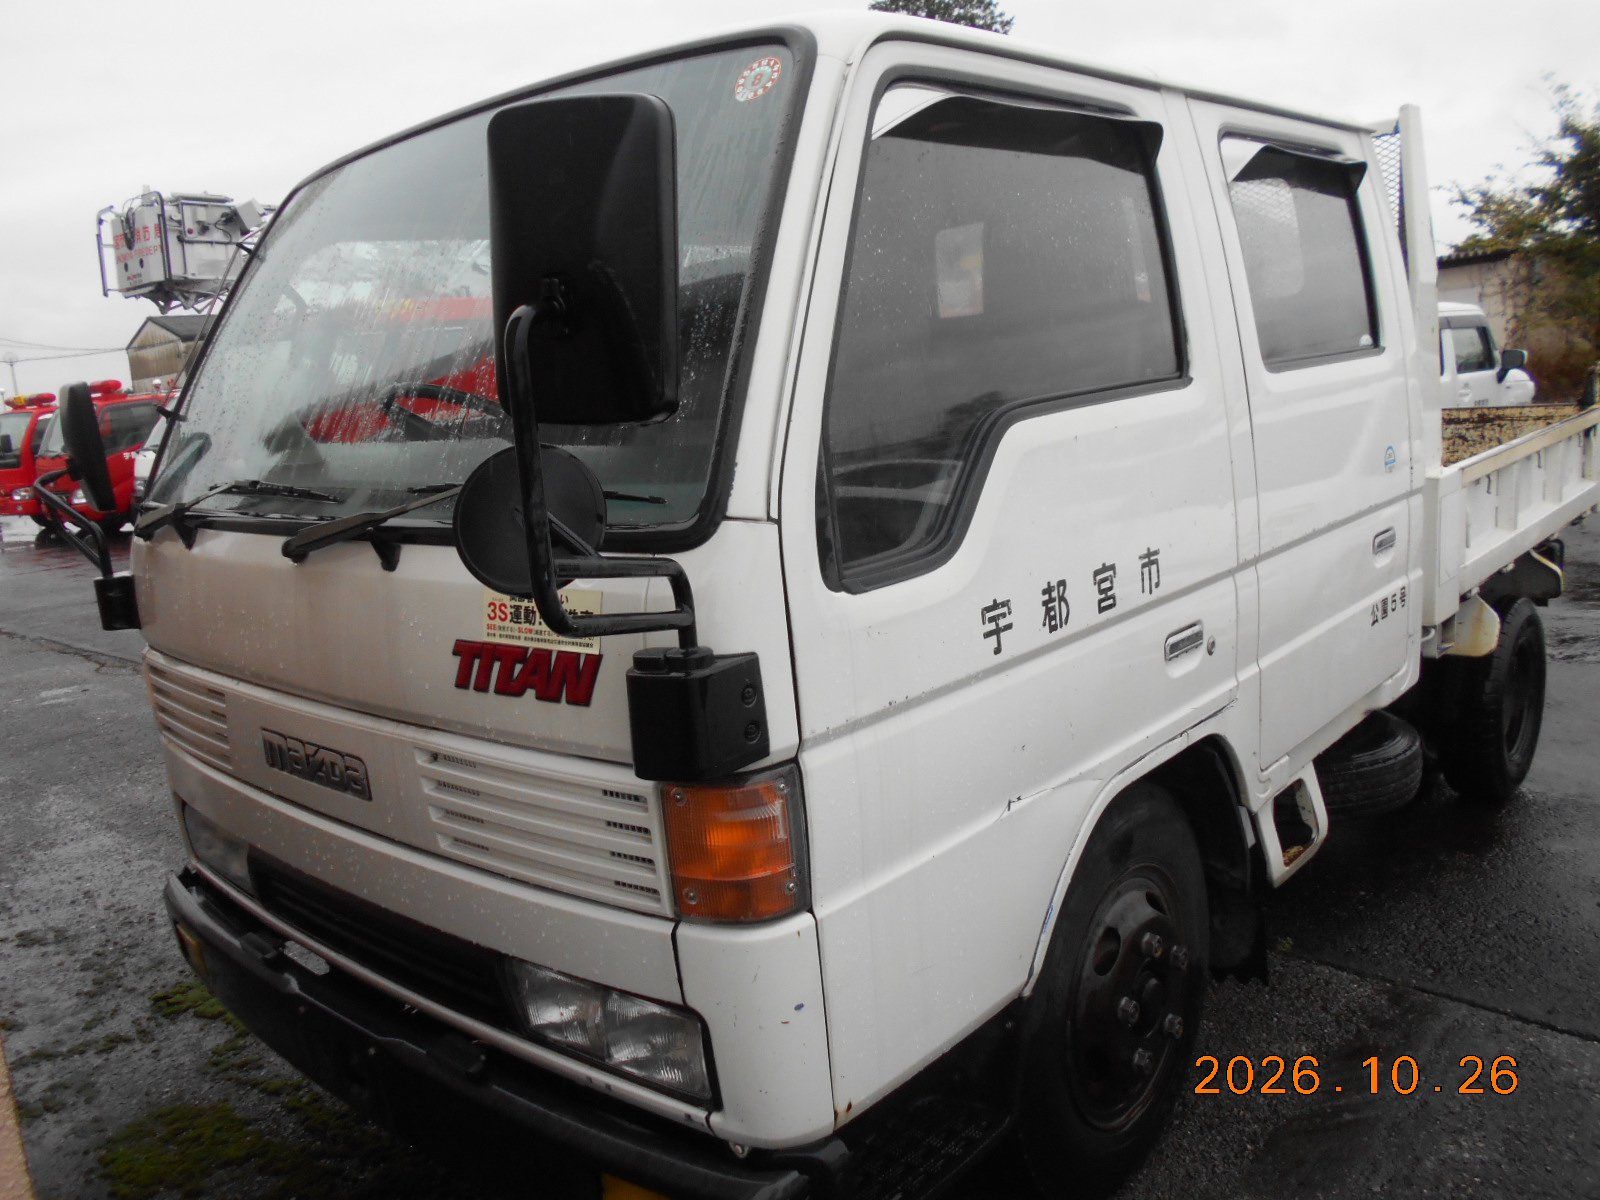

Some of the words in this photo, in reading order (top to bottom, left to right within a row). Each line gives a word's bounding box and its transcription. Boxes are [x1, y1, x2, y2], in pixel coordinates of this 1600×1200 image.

[980, 546, 1161, 656] 宇都宮市
[452, 639, 603, 707] TITAN
